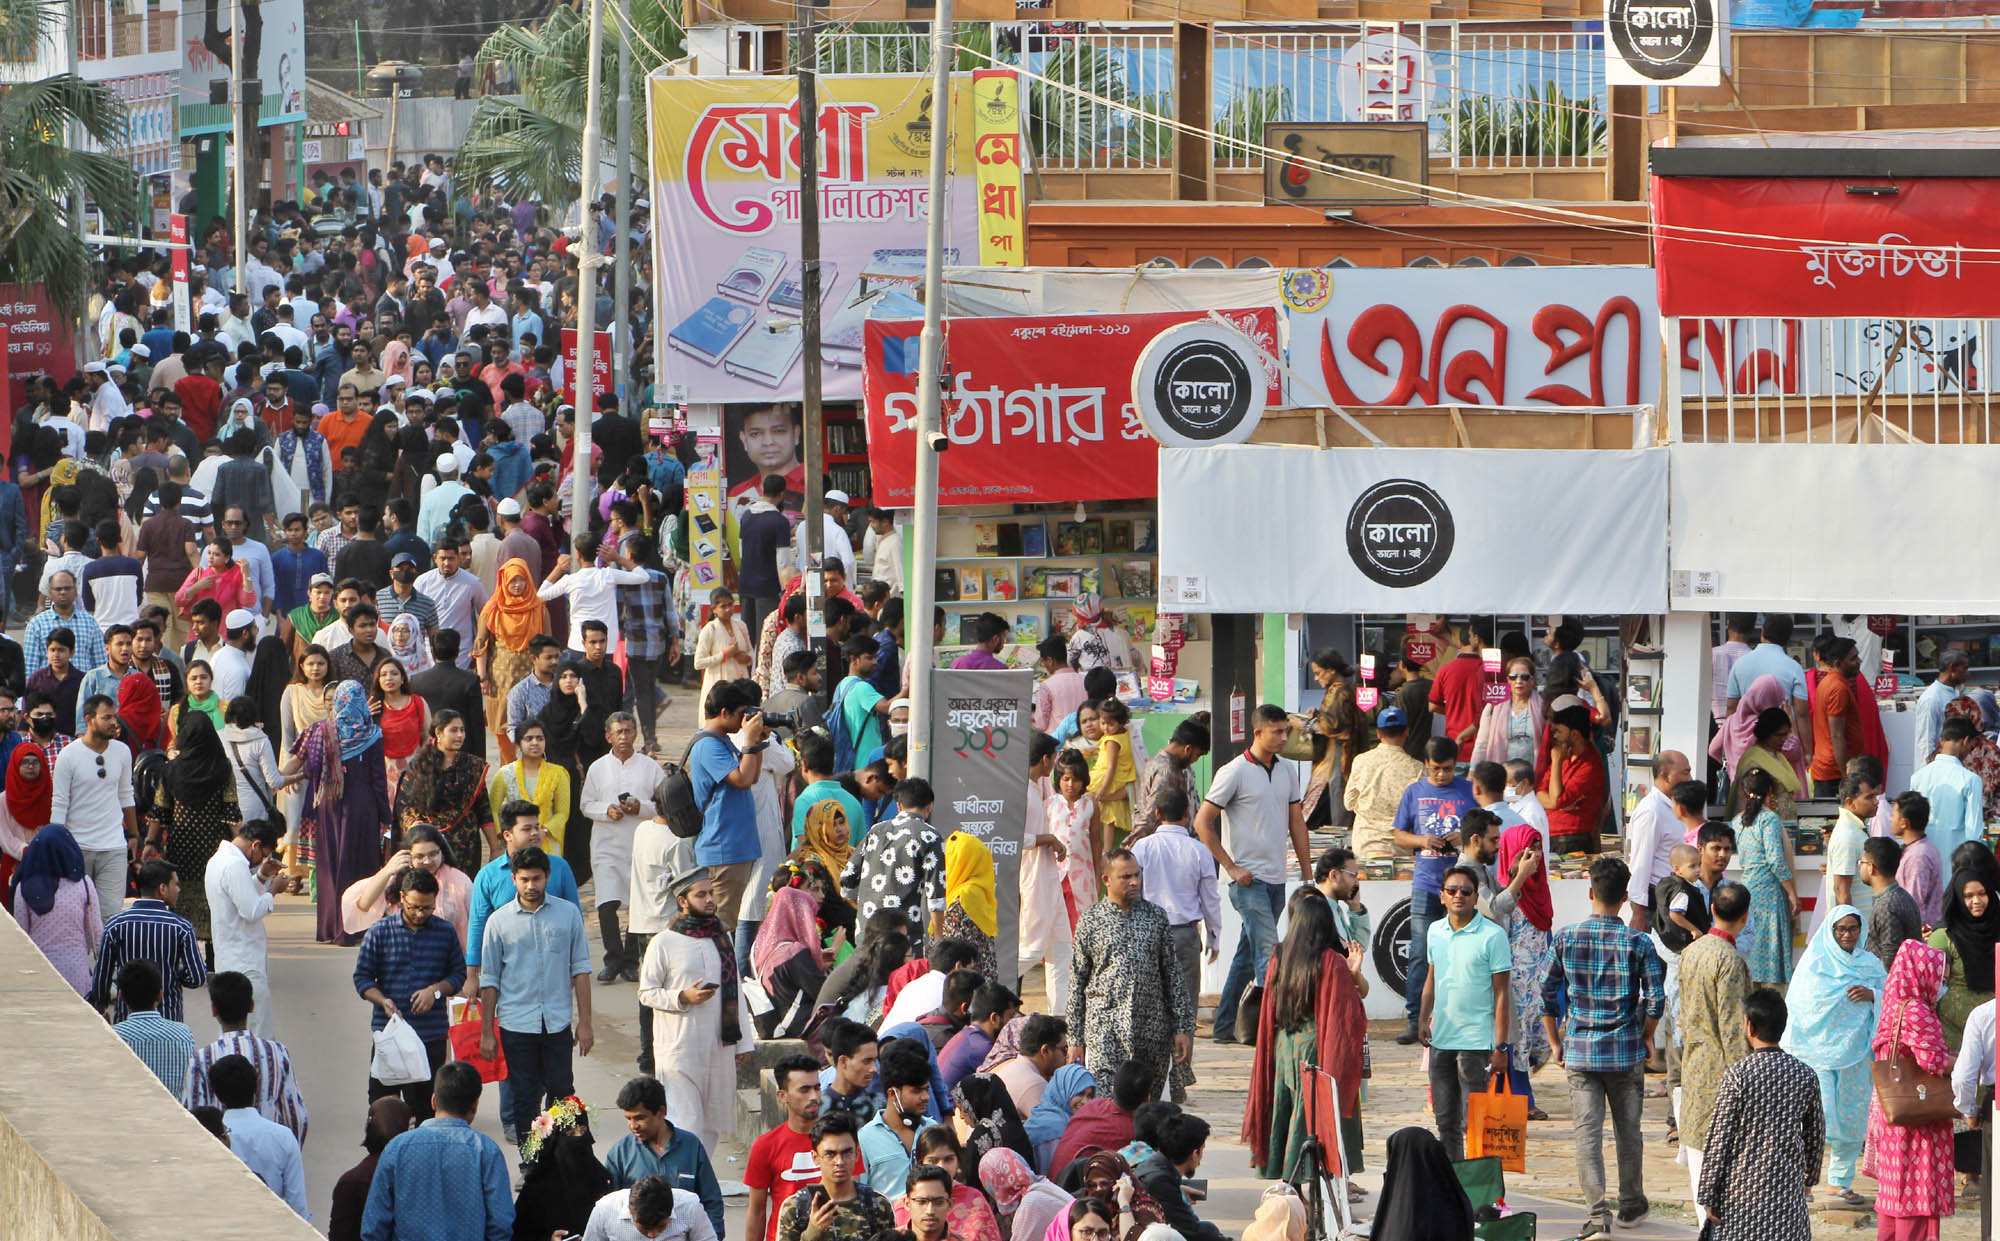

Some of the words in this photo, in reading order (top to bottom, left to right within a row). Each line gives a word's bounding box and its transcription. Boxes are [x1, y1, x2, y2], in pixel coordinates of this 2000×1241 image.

[1629, 7, 1691, 29] কালো
[399, 89, 412, 97] AZI
[684, 94, 877, 235] মেধা
[1173, 381, 1231, 400] কালো
[1367, 523, 1431, 543] কালো
[1377, 549, 1400, 558] ভালো
[1409, 548, 1422, 559] বই
[953, 795, 1004, 814] স্বাধীনতা
